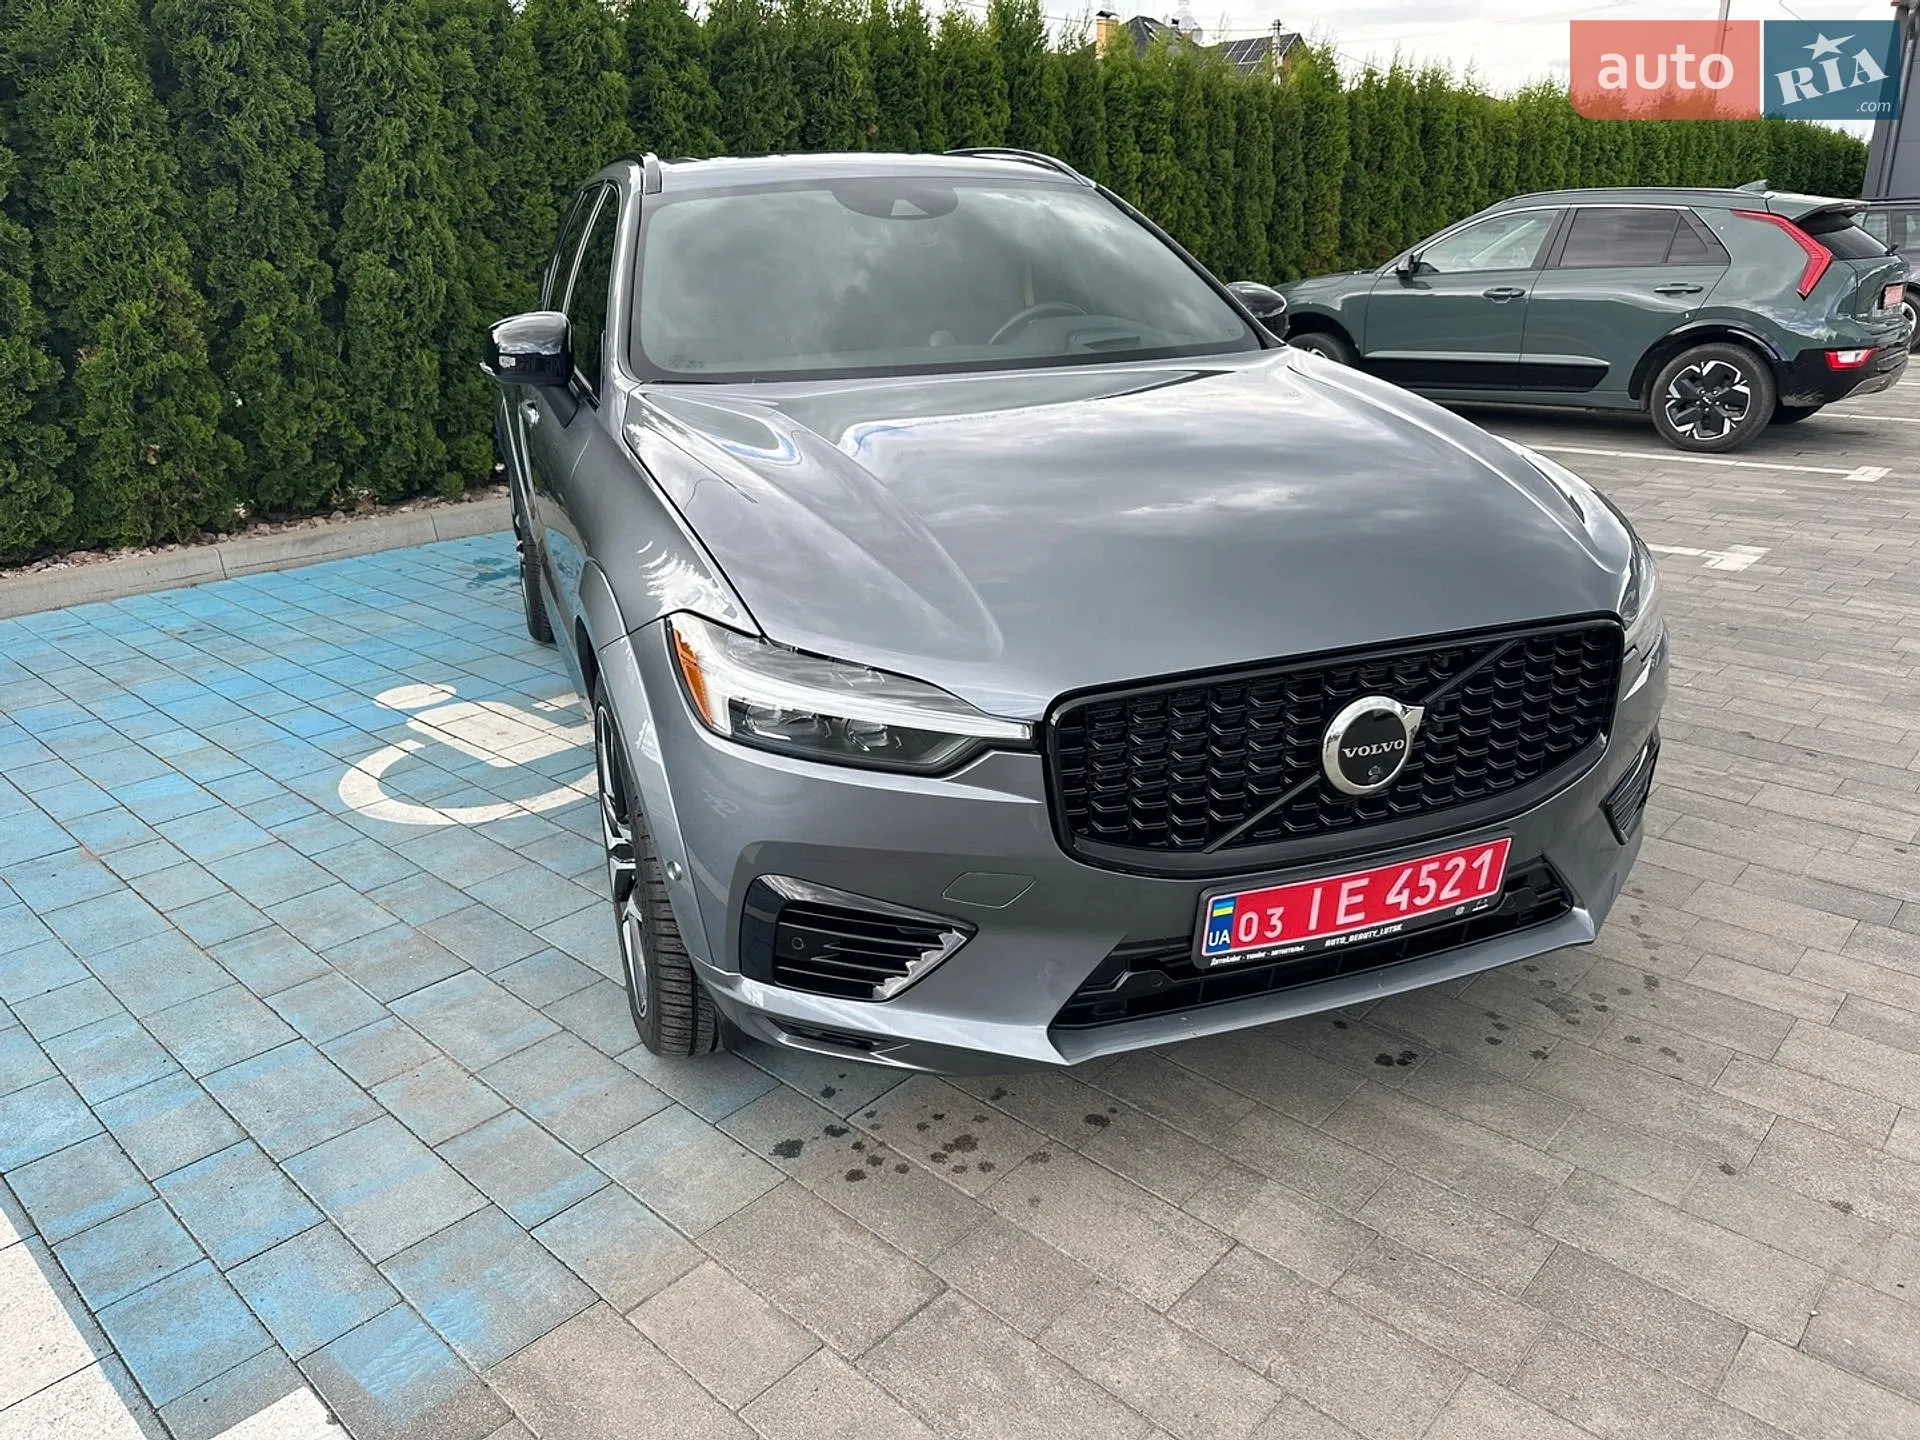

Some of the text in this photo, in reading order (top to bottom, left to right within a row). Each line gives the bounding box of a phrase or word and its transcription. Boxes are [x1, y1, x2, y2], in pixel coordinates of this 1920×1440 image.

[1342, 739, 1404, 758] VOLVO
[1238, 906, 1285, 943] 03
[1385, 848, 1494, 911] 4521
[1208, 929, 1231, 947] UA
